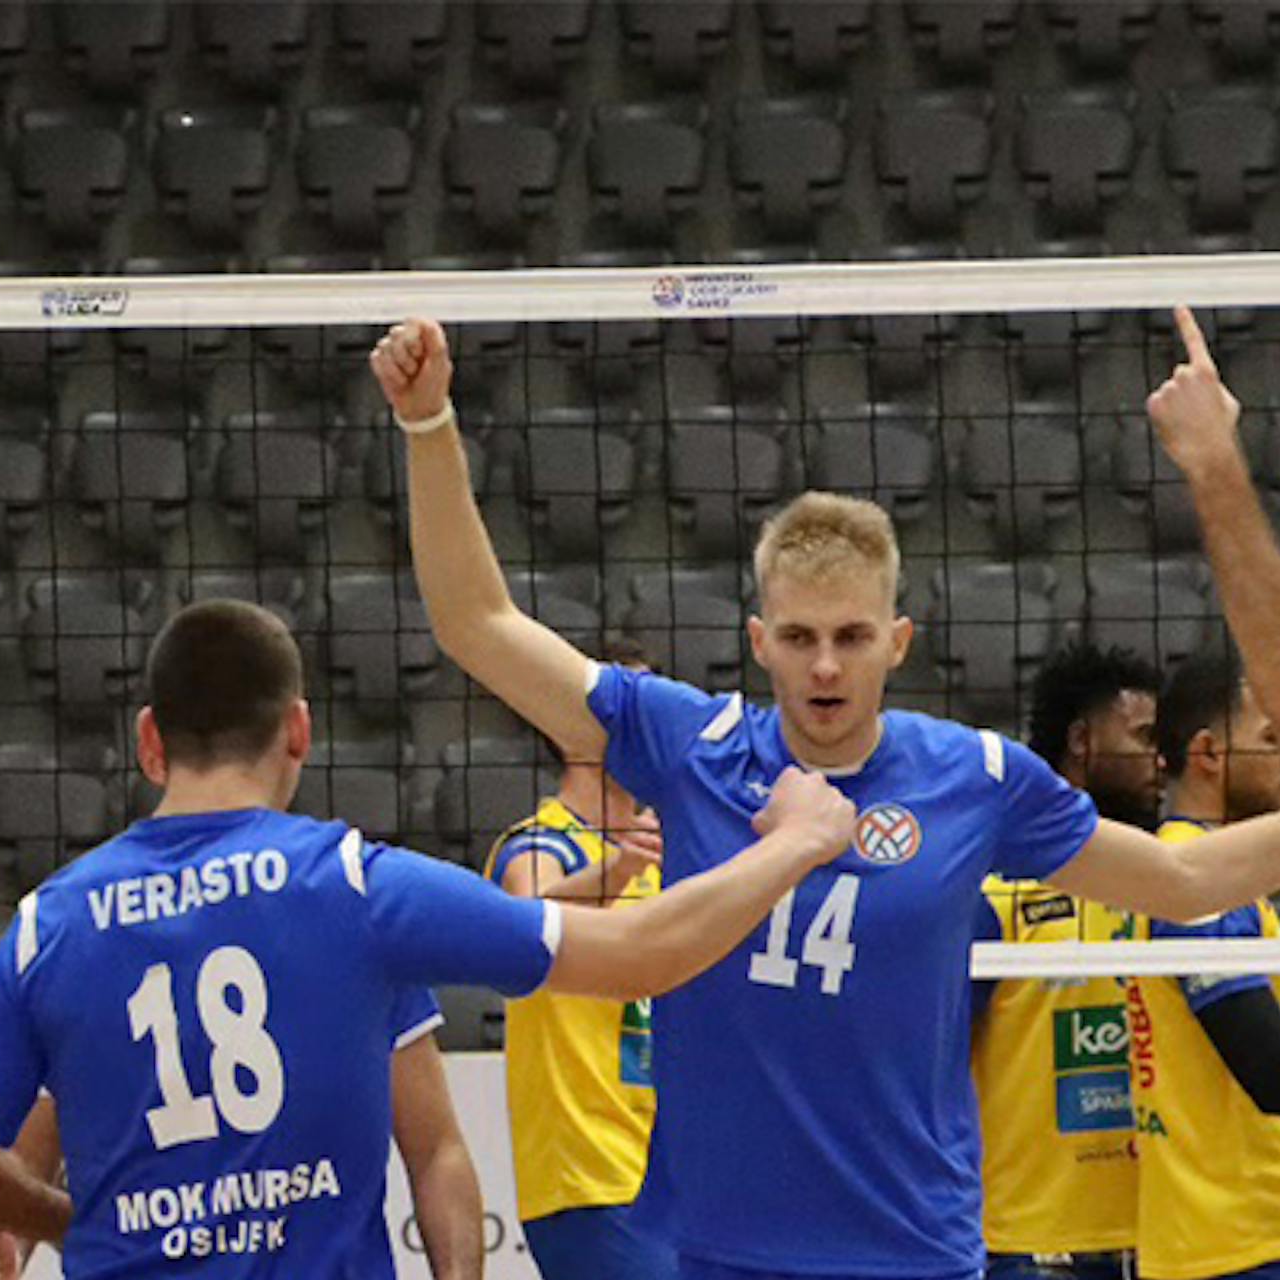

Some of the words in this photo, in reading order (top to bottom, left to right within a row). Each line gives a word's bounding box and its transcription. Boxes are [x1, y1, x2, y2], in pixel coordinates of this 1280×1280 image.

[88, 849, 288, 931] VERASTO
[747, 873, 860, 995] 14
[126, 945, 284, 1150] 18
[116, 1182, 206, 1234] MOK
[212, 1159, 342, 1215] MURSA
